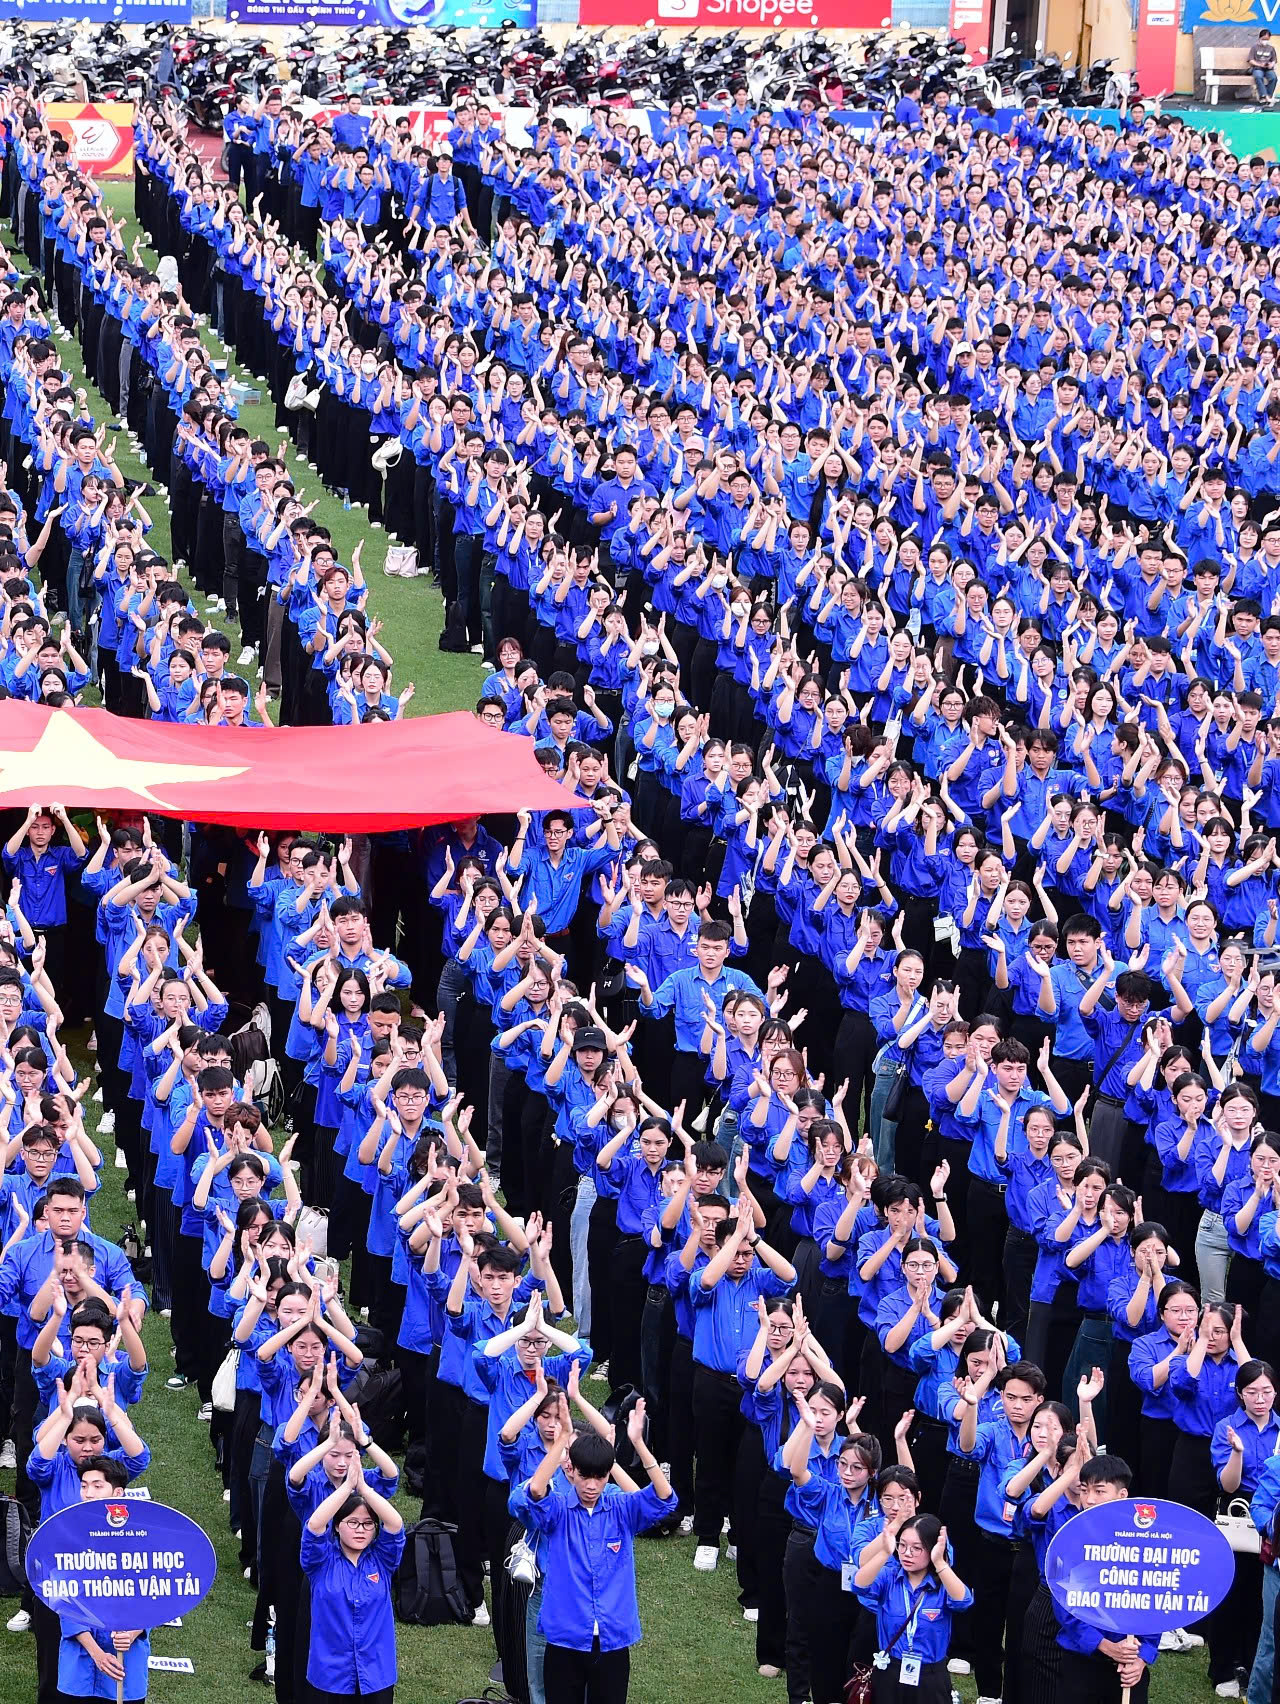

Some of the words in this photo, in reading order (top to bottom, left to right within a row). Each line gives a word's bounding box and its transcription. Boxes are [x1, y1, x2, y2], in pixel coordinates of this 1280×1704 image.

[706, 0, 813, 21] Shopee
[110, 1529, 125, 1537] PHỐ
[125, 1529, 135, 1537] HÀ
[135, 1529, 148, 1538] NỘI
[1114, 1530, 1136, 1538] THÀNH
[1135, 1530, 1150, 1539] PHỐ
[54, 1548, 118, 1571] TRƯỜNG
[121, 1552, 148, 1574] ĐẠI
[152, 1551, 185, 1573] HỌC
[1083, 1541, 1140, 1563] TRƯỜNG
[1143, 1546, 1167, 1566] ĐẠI
[1171, 1548, 1200, 1569] HỌC
[42, 1579, 79, 1598] GIAO
[82, 1576, 135, 1598] THÔNG
[139, 1575, 171, 1600] VẬN
[174, 1572, 200, 1596] TẢI
[1099, 1566, 1138, 1586] CÔNG
[1142, 1568, 1181, 1591] NGHỆ
[1066, 1590, 1100, 1607] GIAO
[1103, 1591, 1151, 1610] THÔNG
[1154, 1592, 1183, 1614] VẬN
[1186, 1590, 1209, 1612] TẢI
